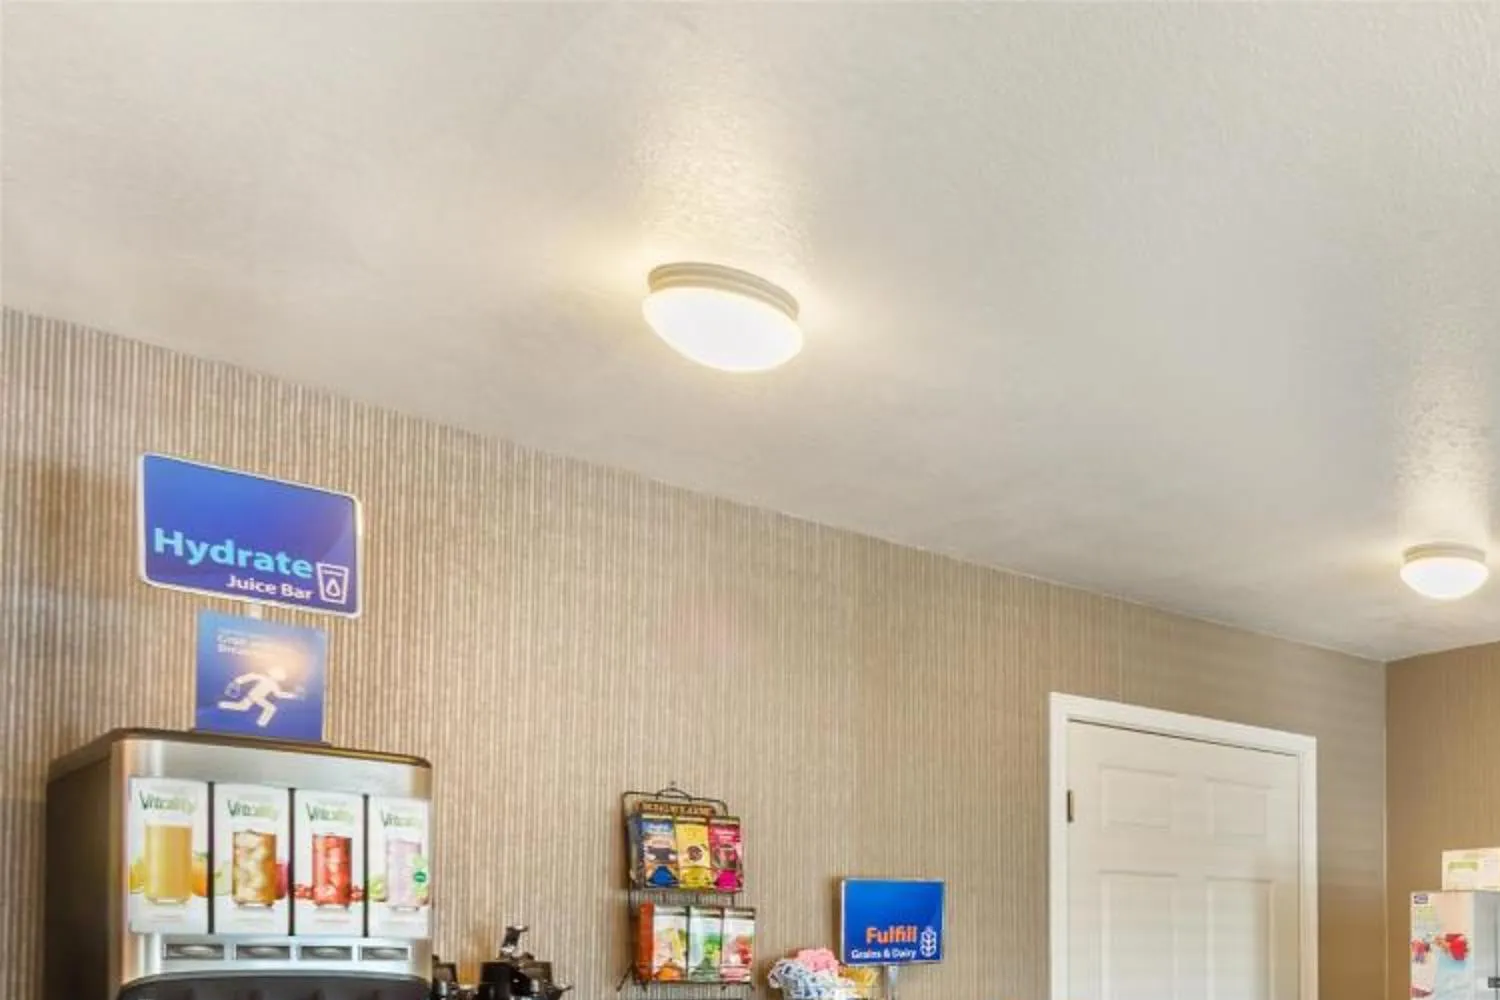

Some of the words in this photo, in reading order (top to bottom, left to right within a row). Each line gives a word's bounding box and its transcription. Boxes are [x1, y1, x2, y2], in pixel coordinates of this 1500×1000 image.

[154, 527, 313, 579] Hydrate
[226, 574, 277, 595] Juice
[281, 583, 315, 600] Bar
[866, 925, 917, 944] Fulfill
[851, 949, 881, 959] Grains
[892, 948, 917, 960] Dairy
